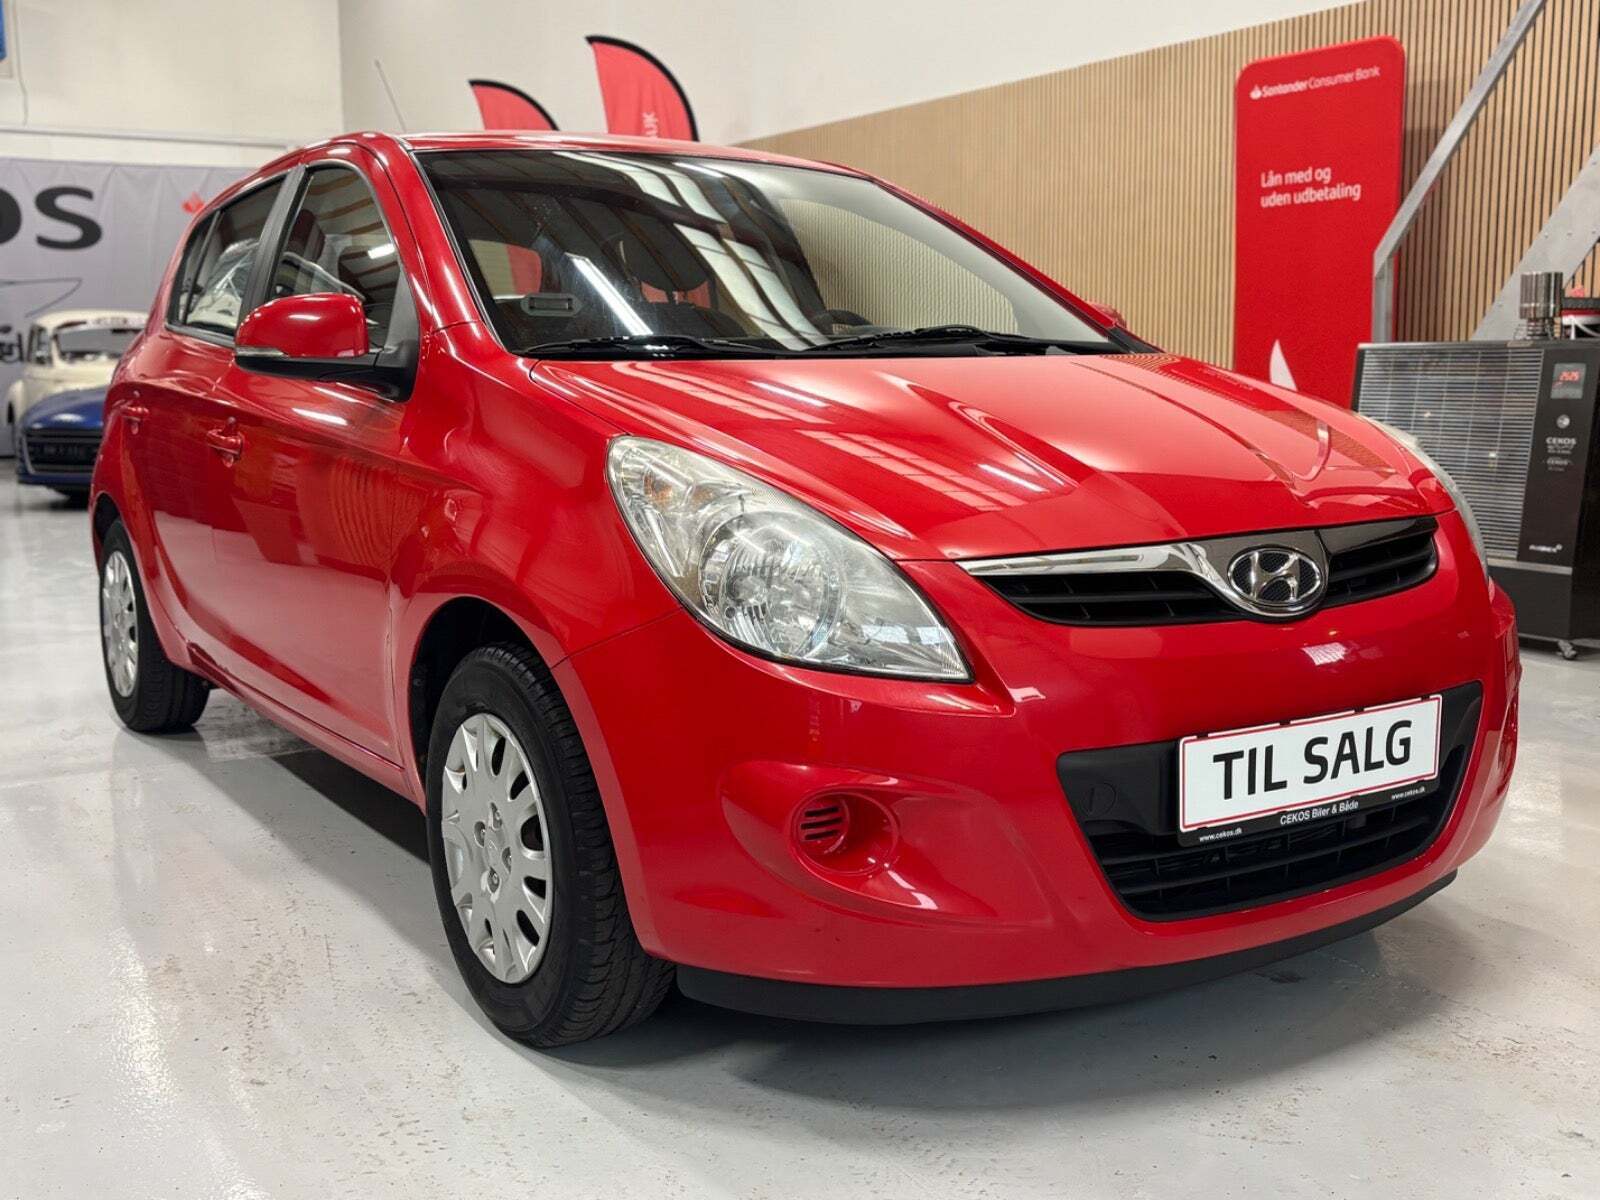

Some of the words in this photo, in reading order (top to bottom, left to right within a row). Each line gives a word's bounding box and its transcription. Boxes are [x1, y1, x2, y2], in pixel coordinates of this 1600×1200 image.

[1262, 80, 1308, 98] Santander
[1355, 66, 1380, 80] Bank
[1260, 170, 1283, 188] Lån
[1284, 166, 1313, 185] med
[1314, 166, 1332, 184] og
[1260, 190, 1292, 208] uden
[1293, 182, 1362, 202] udbetaling
[1212, 744, 1288, 800] TIL
[1303, 720, 1412, 784] SALG
[1391, 785, 1426, 800] www.cekos.dk
[1280, 809, 1310, 826] CEKOS
[1311, 806, 1331, 820] Biler
[1331, 804, 1338, 815] &
[1339, 799, 1359, 812] Både
[1199, 826, 1243, 842] www.cekos.dk
